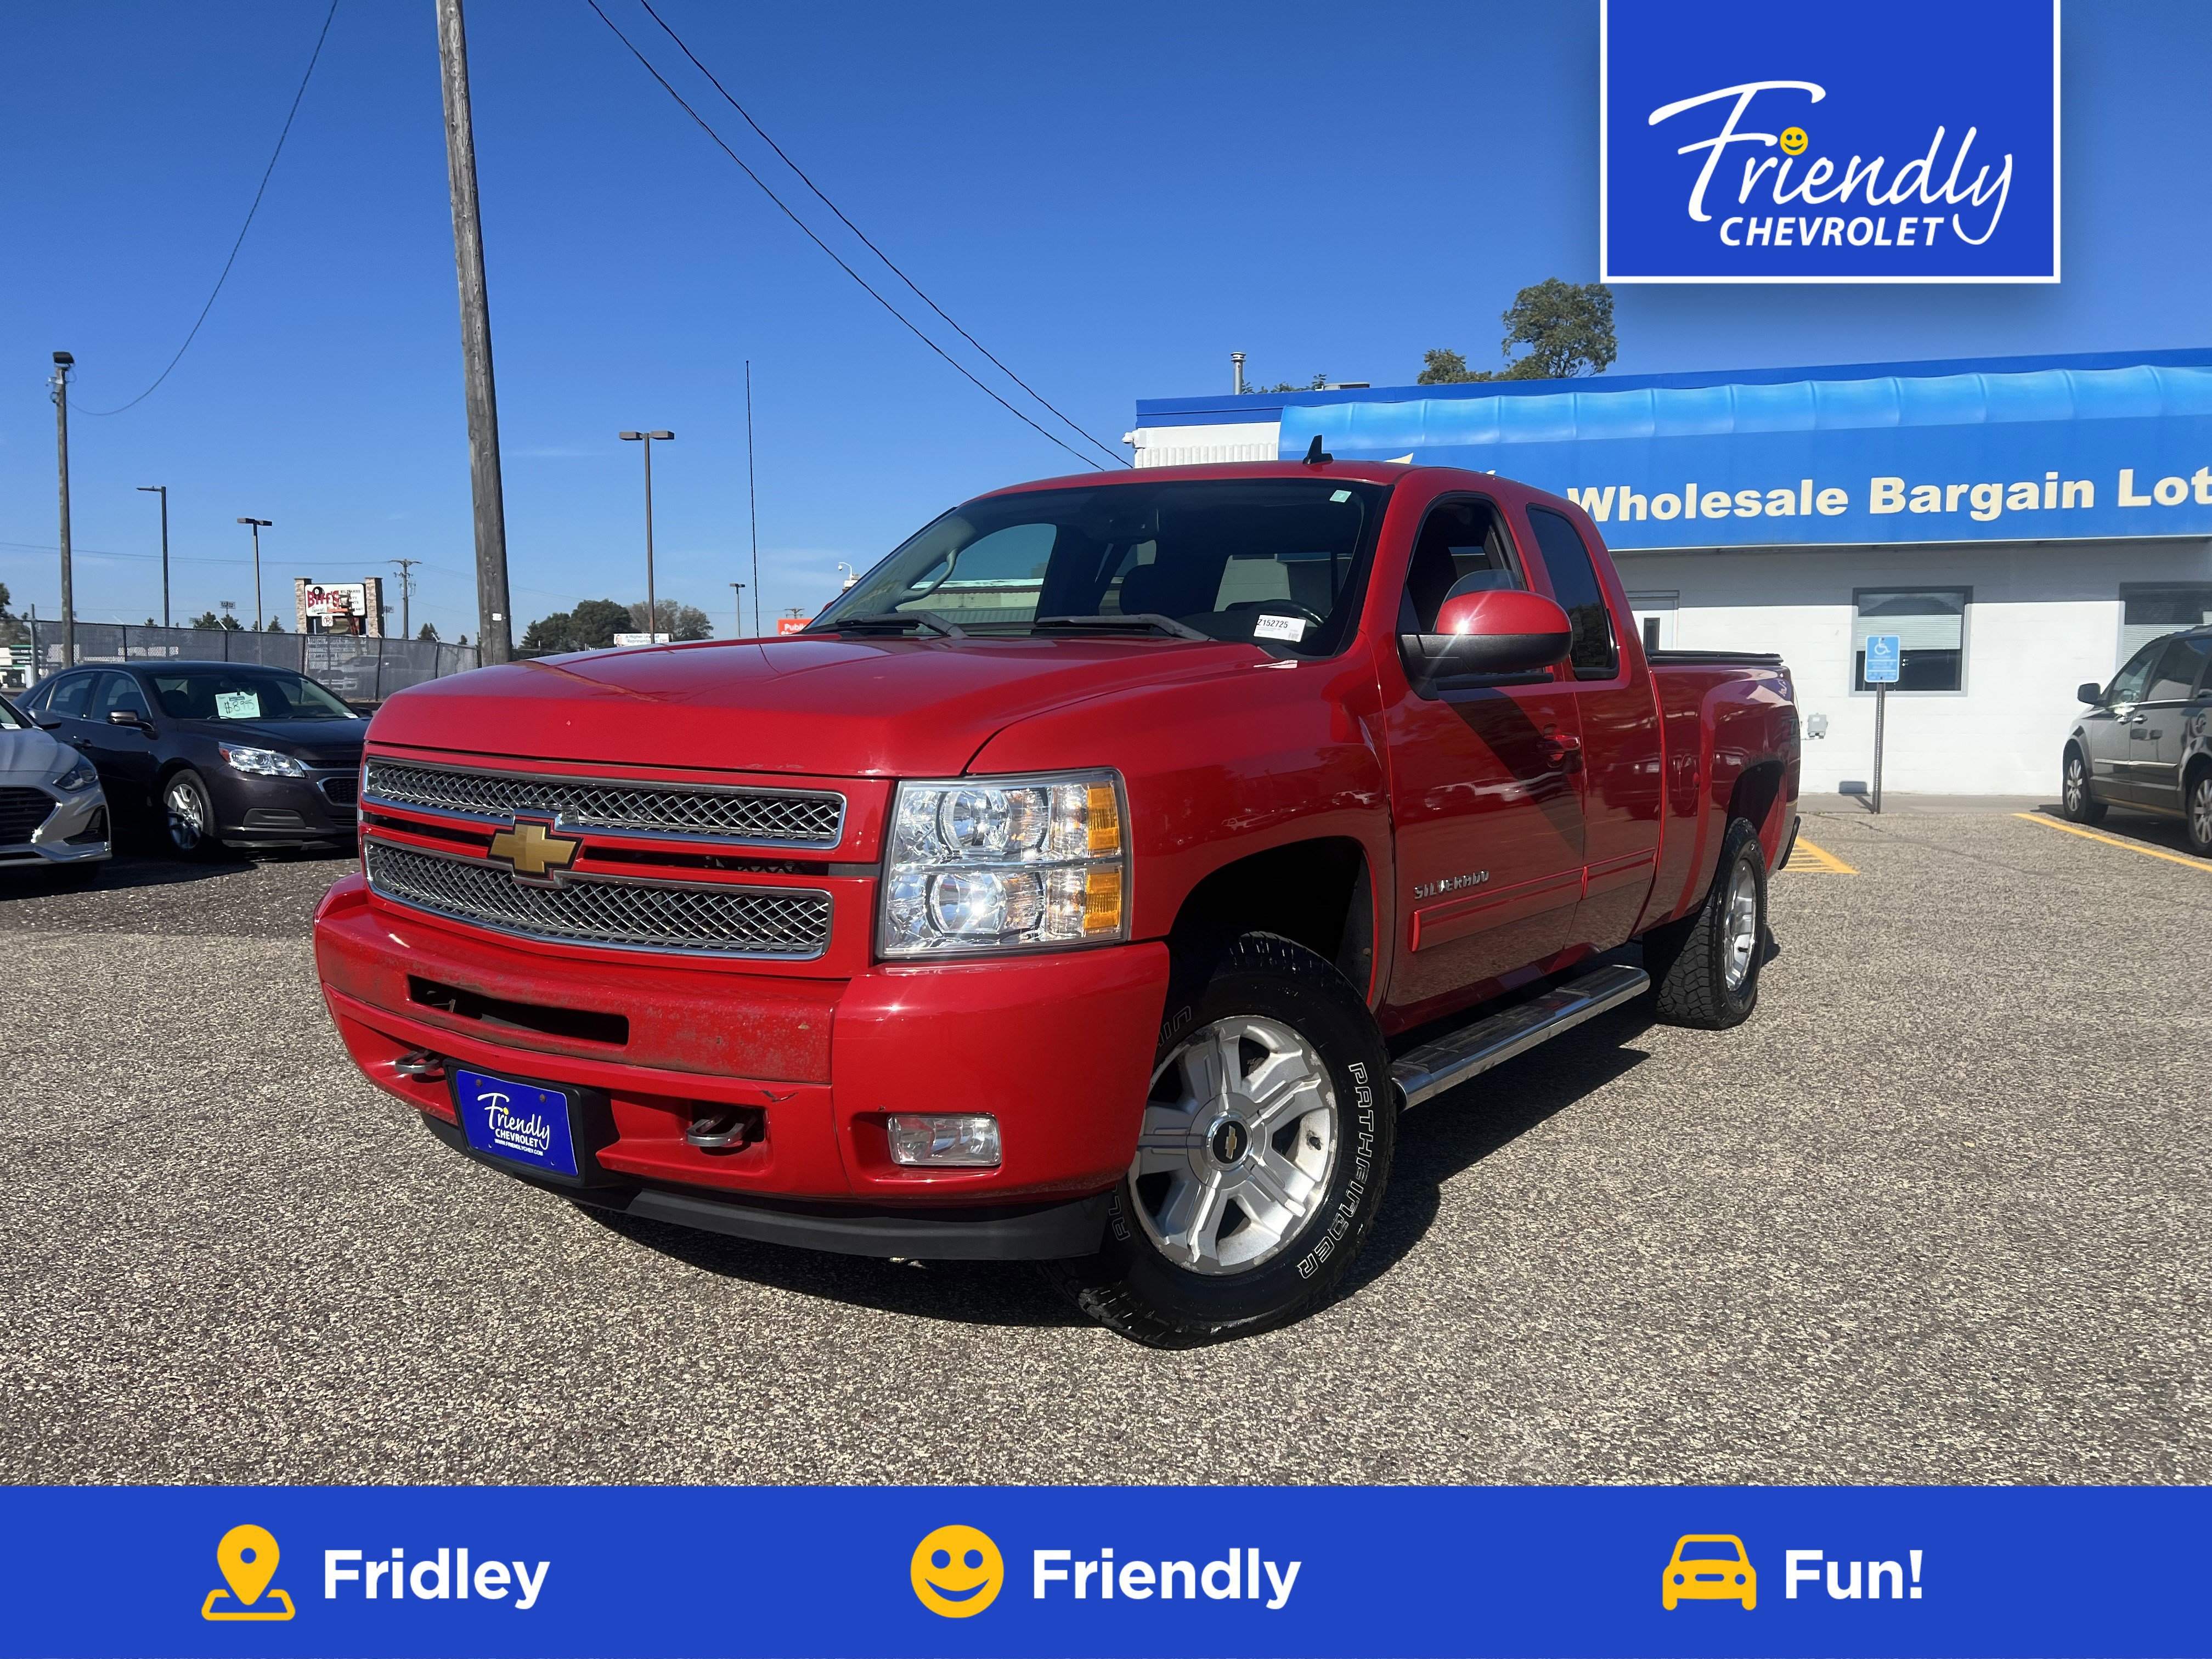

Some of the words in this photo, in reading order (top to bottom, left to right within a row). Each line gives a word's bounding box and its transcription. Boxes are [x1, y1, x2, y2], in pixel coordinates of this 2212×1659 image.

[1567, 479, 1849, 522] Wholesale
[1869, 471, 2095, 522] Bargain
[2118, 466, 2212, 507] Lot
[1414, 870, 1489, 900] SILVERADO
[477, 1092, 550, 1150] Friendly
[495, 1128, 539, 1148] CHEVROLET
[1296, 1062, 1375, 1279] PATHFINDER
